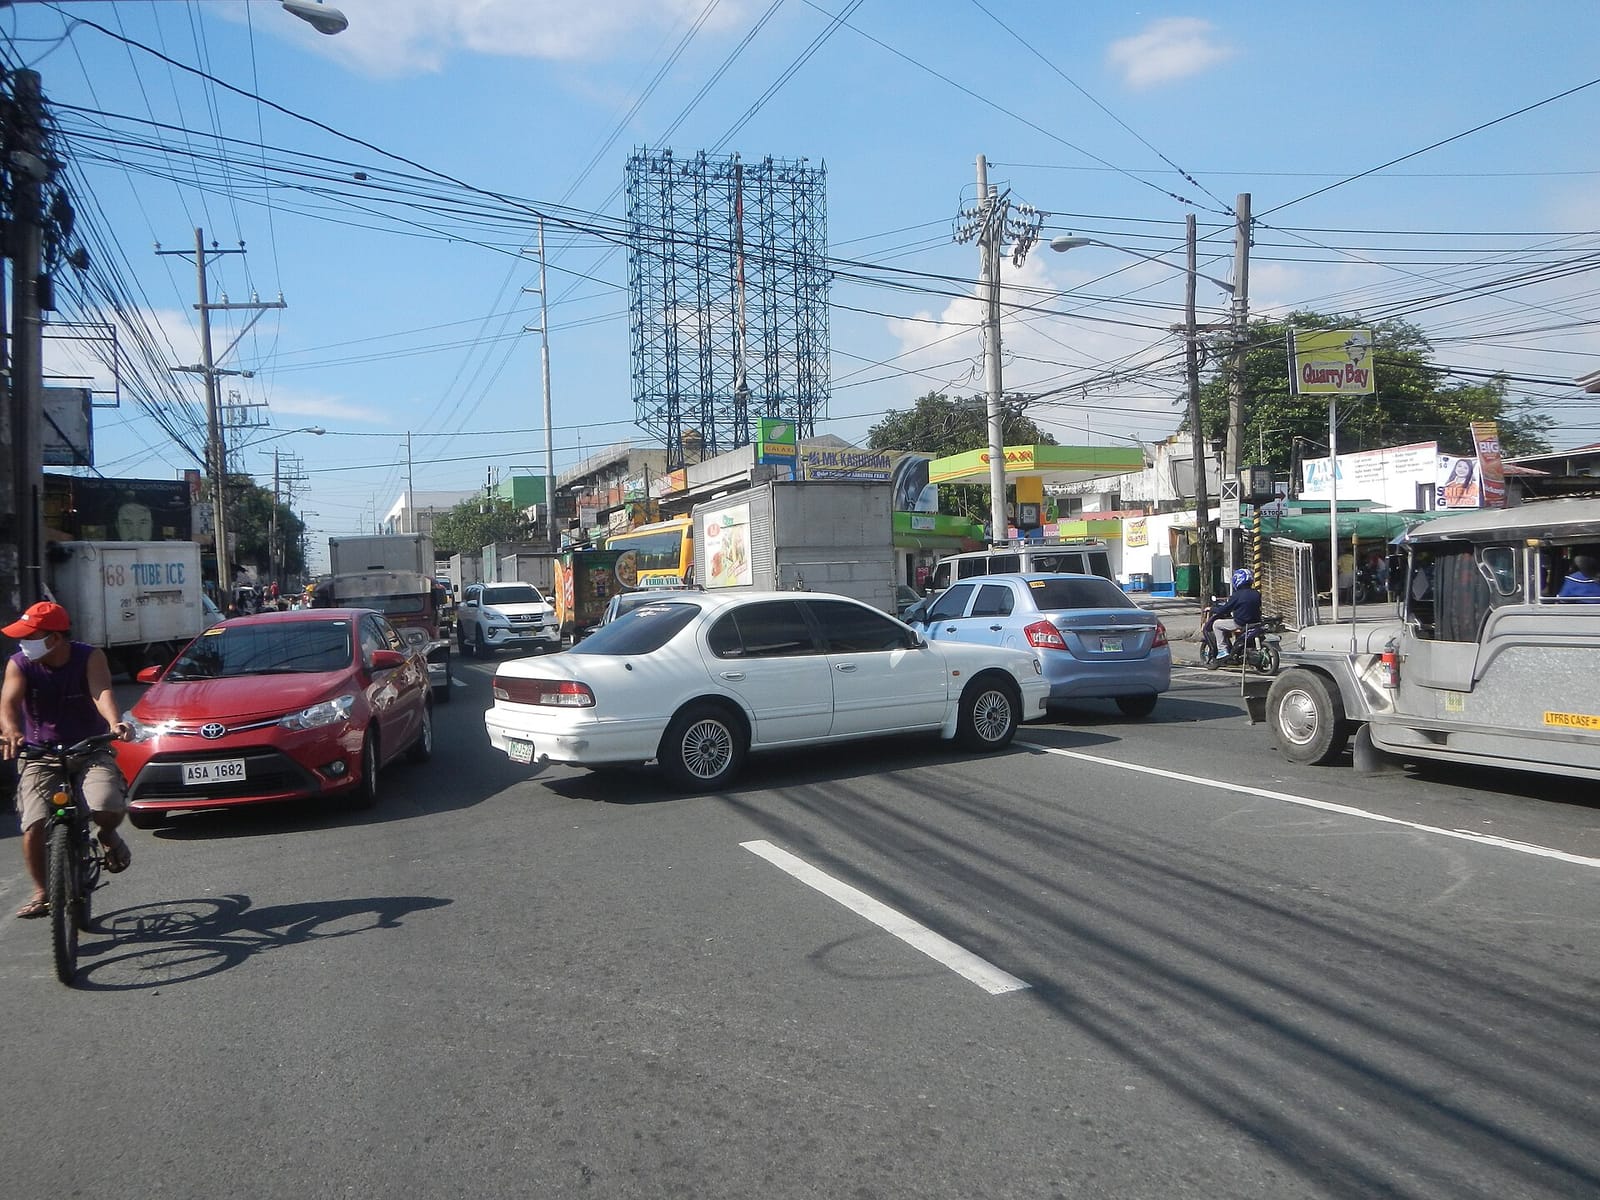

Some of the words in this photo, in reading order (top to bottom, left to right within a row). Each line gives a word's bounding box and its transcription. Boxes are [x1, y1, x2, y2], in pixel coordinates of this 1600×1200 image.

[1303, 363, 1343, 388] Quarry
[1345, 363, 1369, 388] Bay
[1479, 441, 1499, 453] BIG
[130, 562, 163, 586] TUBE
[166, 562, 186, 585] ICE
[1545, 713, 1569, 725] LTFRB
[1571, 715, 1590, 727] CASE
[188, 766, 209, 779] ASA
[214, 763, 243, 777] 1682
